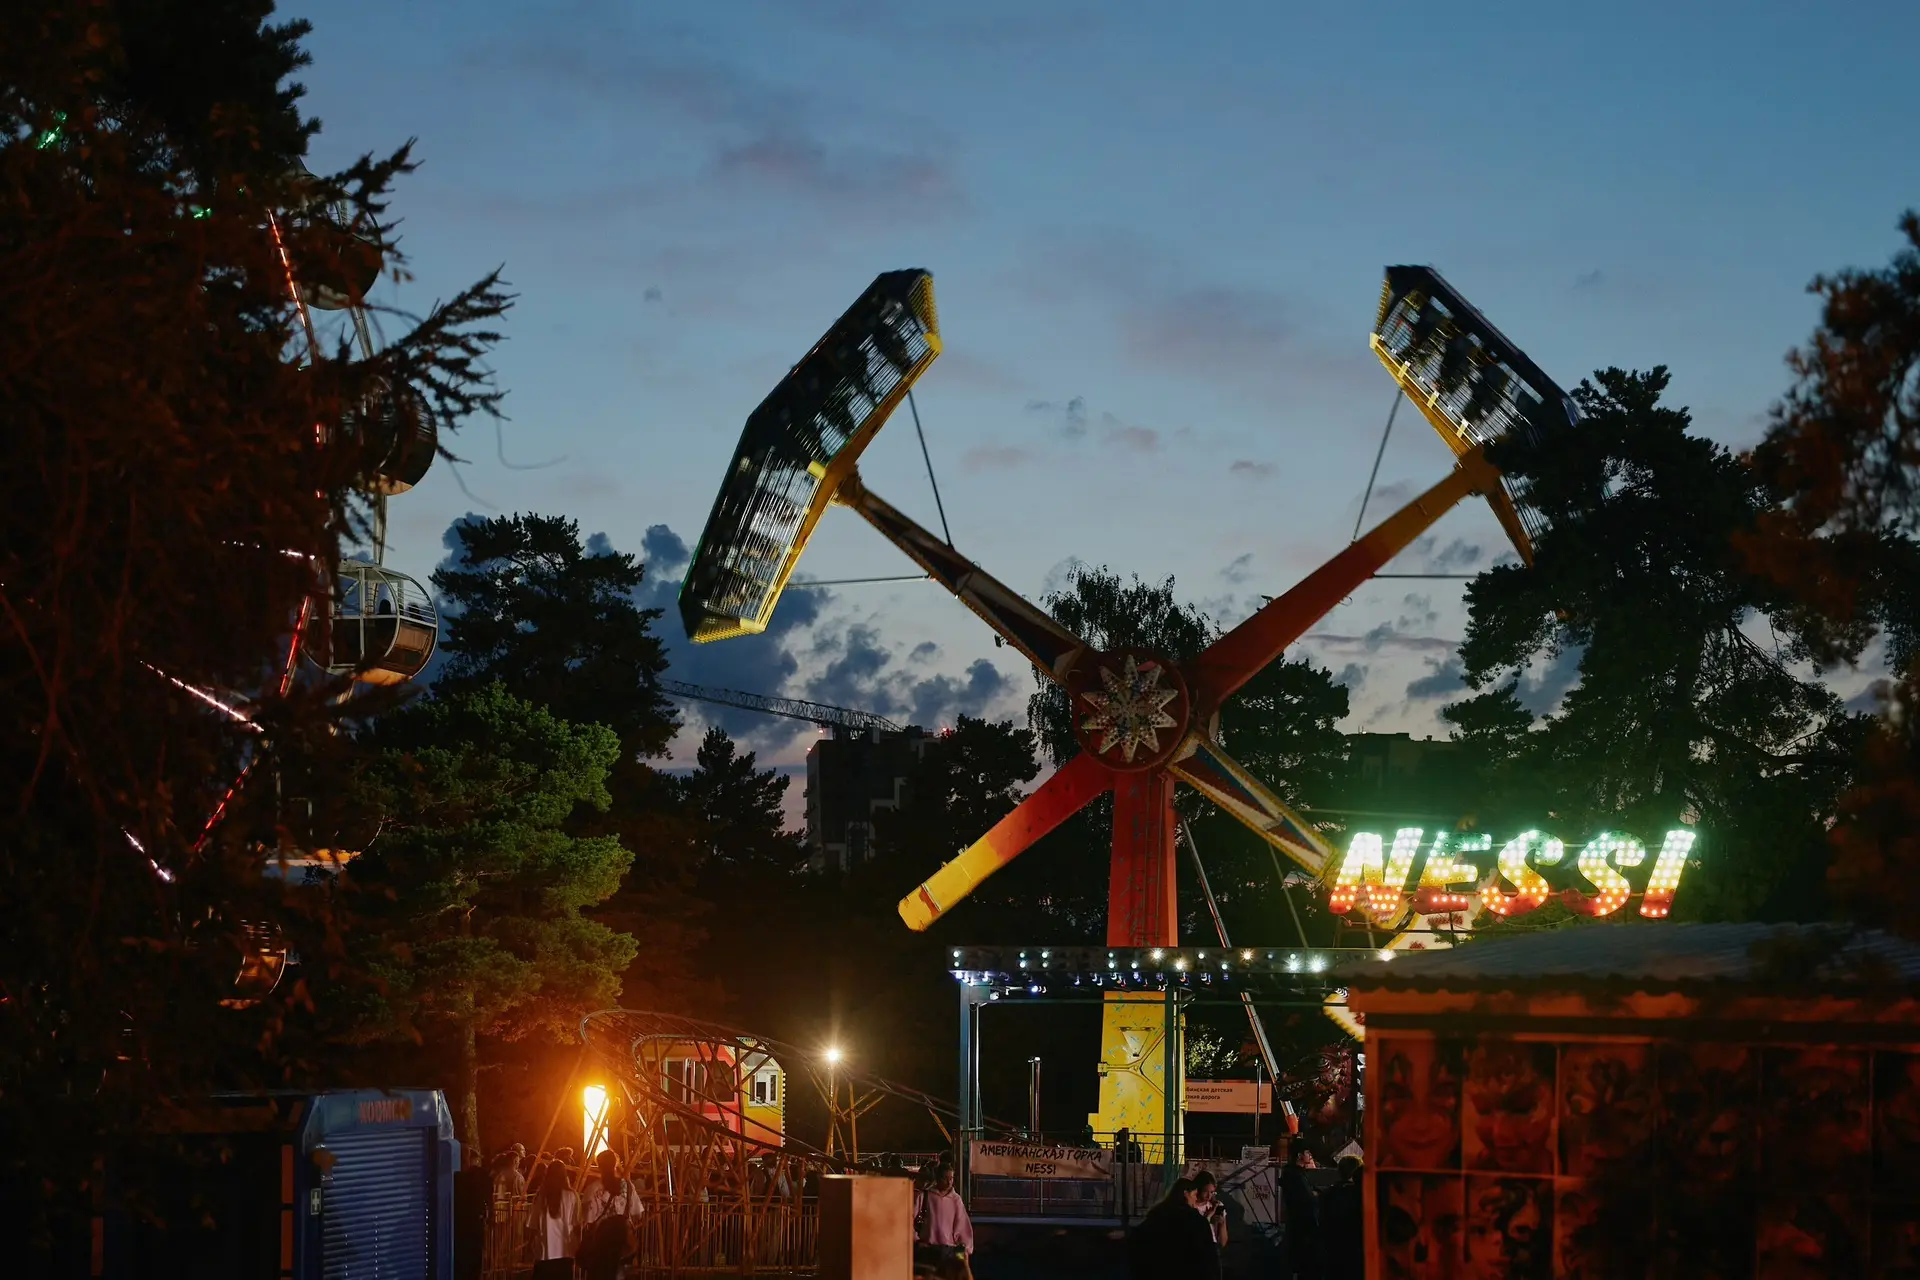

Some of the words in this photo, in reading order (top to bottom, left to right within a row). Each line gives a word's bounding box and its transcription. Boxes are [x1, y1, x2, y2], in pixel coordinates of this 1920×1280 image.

[1329, 827, 1696, 918] NESSI
[980, 1143, 1063, 1160] АМЕРИКАНСКАЯ
[1066, 1149, 1102, 1164] ГОРКА
[1025, 1163, 1056, 1175] NESSI
